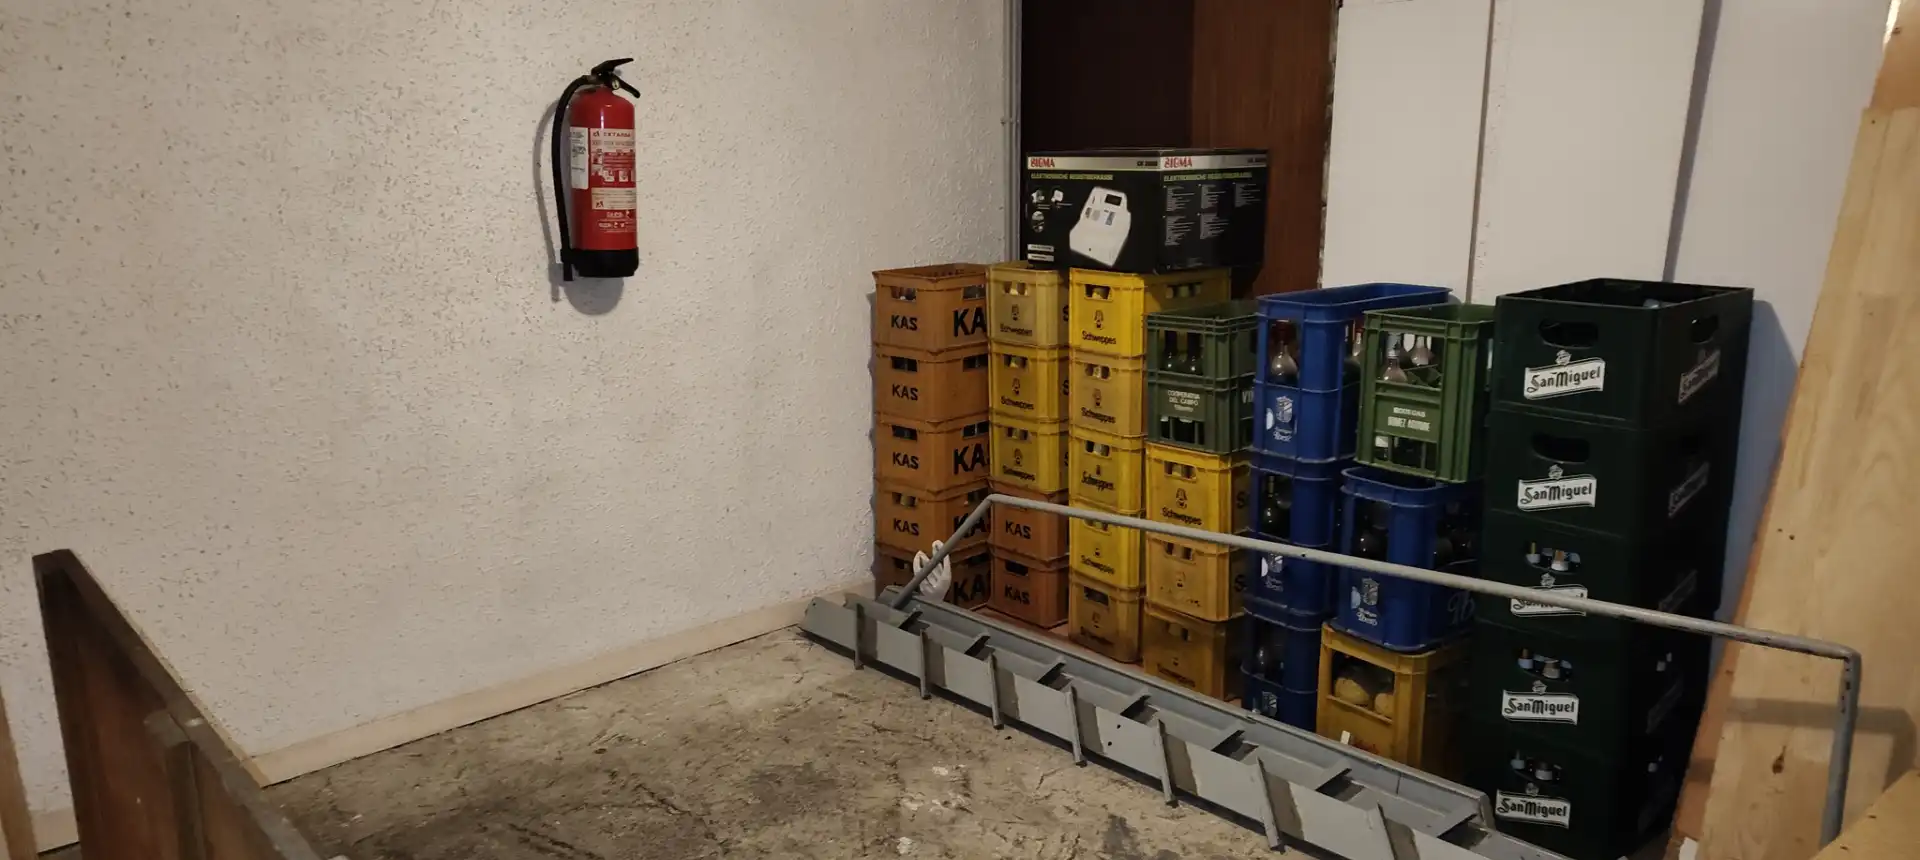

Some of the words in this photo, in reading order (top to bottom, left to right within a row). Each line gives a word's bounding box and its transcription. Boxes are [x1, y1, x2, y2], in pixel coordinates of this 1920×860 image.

[1030, 158, 1055, 168] SIGMA
[1164, 156, 1193, 168] SIGMA
[891, 314, 918, 332] KAS
[953, 307, 987, 337] KA
[1082, 330, 1117, 345] Schweppes
[1527, 373, 1556, 393] San
[1556, 366, 1600, 388] Miguel
[892, 384, 918, 401] KAS
[1000, 395, 1035, 410] Schweppes
[1081, 407, 1116, 424] Schweppes
[892, 452, 919, 470] KAS
[953, 443, 990, 475] KA
[1520, 486, 1549, 504] San
[1549, 483, 1592, 500] Miguel
[1161, 507, 1203, 526] Schweppes
[893, 518, 920, 536] KAS
[1005, 520, 1031, 540] KAS
[953, 574, 990, 606] KA
[1004, 584, 1031, 605] KAS
[1504, 698, 1533, 714] San
[1532, 700, 1575, 715] Miguel
[1497, 798, 1525, 814] San
[1524, 802, 1567, 818] Miguel
